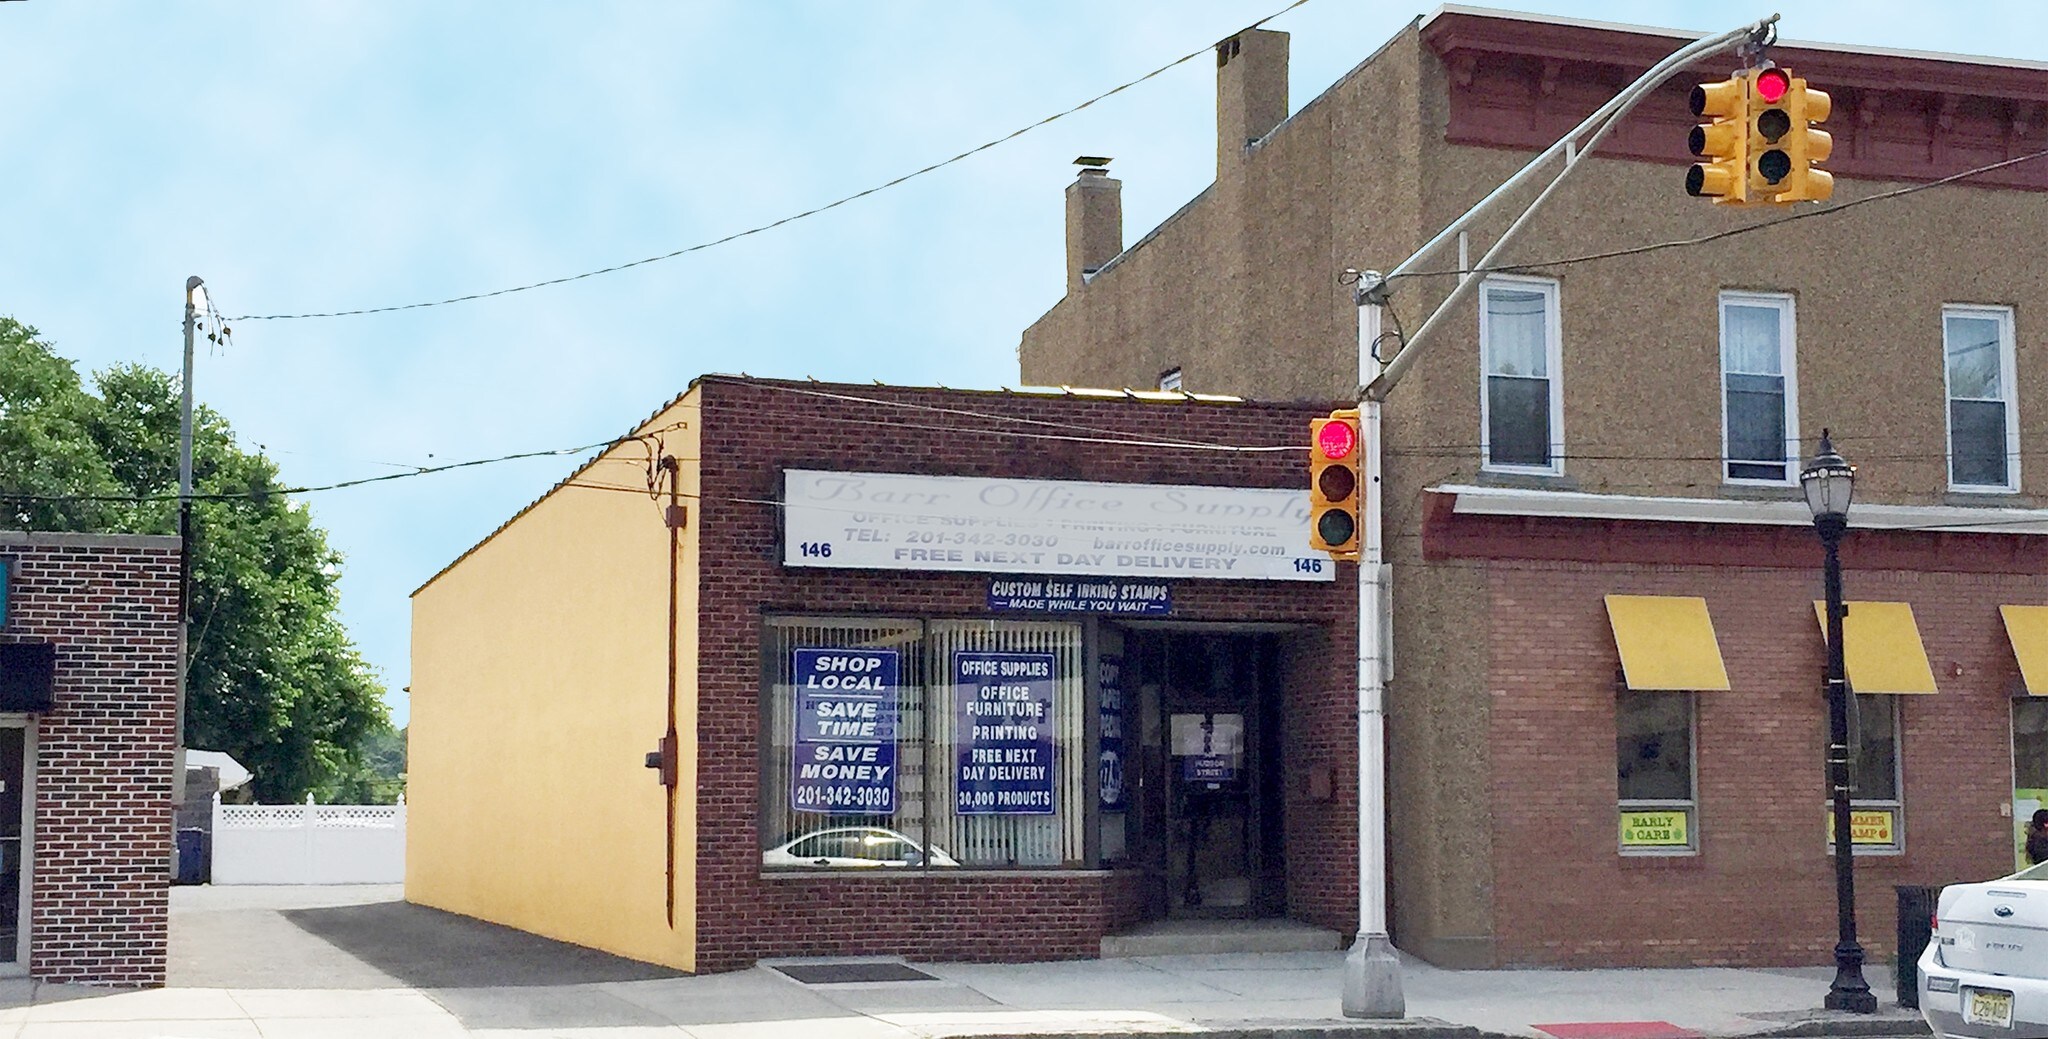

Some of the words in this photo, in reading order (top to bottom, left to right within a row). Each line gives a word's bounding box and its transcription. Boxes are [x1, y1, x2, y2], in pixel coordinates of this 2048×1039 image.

[807, 477, 953, 506] Barr
[978, 482, 1124, 512] Office
[1150, 489, 1312, 527] Supply
[853, 511, 930, 525] OFFICE
[940, 514, 1039, 528] SUPPLIES
[1170, 521, 1277, 538] FURNITURE
[843, 527, 891, 543] TEL:
[905, 530, 1059, 547] 201-342-3030
[800, 542, 832, 558] 146
[1093, 536, 1286, 556] barrofficesupply.com
[894, 548, 963, 562] FREE
[974, 550, 1045, 565] NEXT
[1057, 553, 1106, 567] DAY
[1117, 554, 1238, 571] DELIVERY
[1293, 558, 1322, 574] 146
[991, 580, 1041, 597] CUSTOM
[1045, 582, 1074, 598] SELF
[1077, 583, 1117, 600] INKING
[1120, 584, 1168, 601] STAMPS
[1009, 599, 1045, 609] MADE
[1048, 600, 1086, 611] WHILE
[1090, 601, 1115, 611] YOU
[1117, 601, 1149, 612] WAIT
[815, 656, 882, 672] SHOP
[961, 660, 998, 676] OFFICE
[1001, 661, 1049, 677] SUPPLIES
[807, 675, 886, 690] LOCAL
[981, 686, 1030, 700] OFFICE
[816, 702, 878, 718] SAVE
[966, 702, 1044, 717] FURNITURE
[817, 721, 877, 737] TIME
[972, 725, 1037, 740] PRINTING
[814, 746, 879, 762] SAVE
[972, 748, 1002, 763] FREE
[1005, 748, 1037, 763] NEXT
[800, 764, 890, 780] MONEY
[963, 766, 985, 781] DAY
[989, 766, 1046, 781] DELIVERY
[797, 785, 890, 806] 201-342-3030
[959, 791, 995, 808] 30,000
[998, 791, 1050, 806] PRODUCTS
[1632, 816, 1674, 827] EARLY
[1851, 815, 1885, 826] MMER
[1637, 829, 1671, 840] CARE
[1852, 828, 1878, 838] AMP
